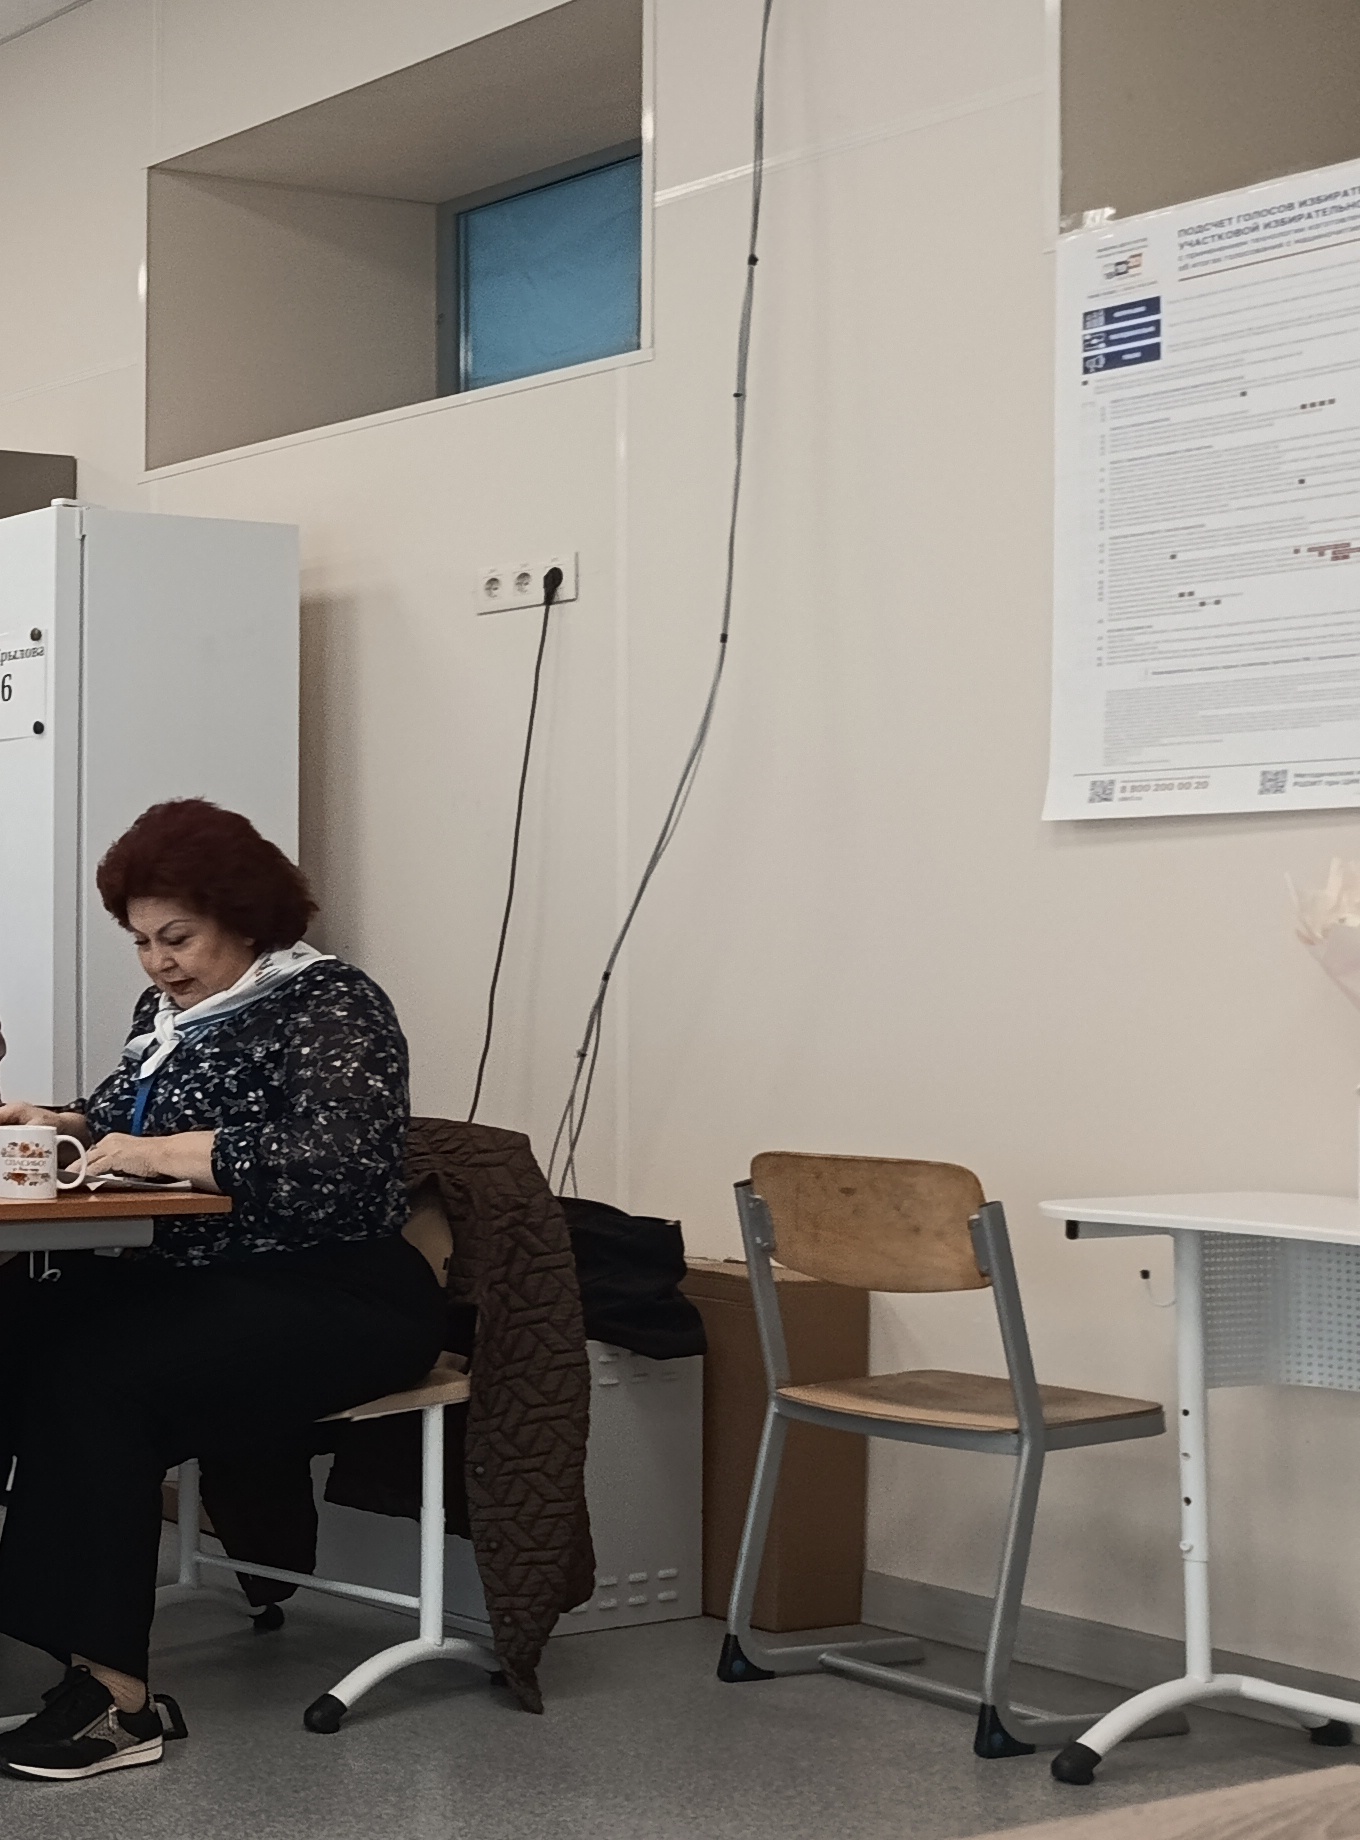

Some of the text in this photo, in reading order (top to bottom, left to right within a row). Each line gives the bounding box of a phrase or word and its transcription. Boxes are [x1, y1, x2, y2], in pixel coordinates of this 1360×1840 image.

[1177, 217, 1233, 238] ПОДСЧЕТ
[1236, 202, 1295, 224] ГОЛОСОВ
[1178, 222, 1260, 250] УЧАСТКОВОЙ
